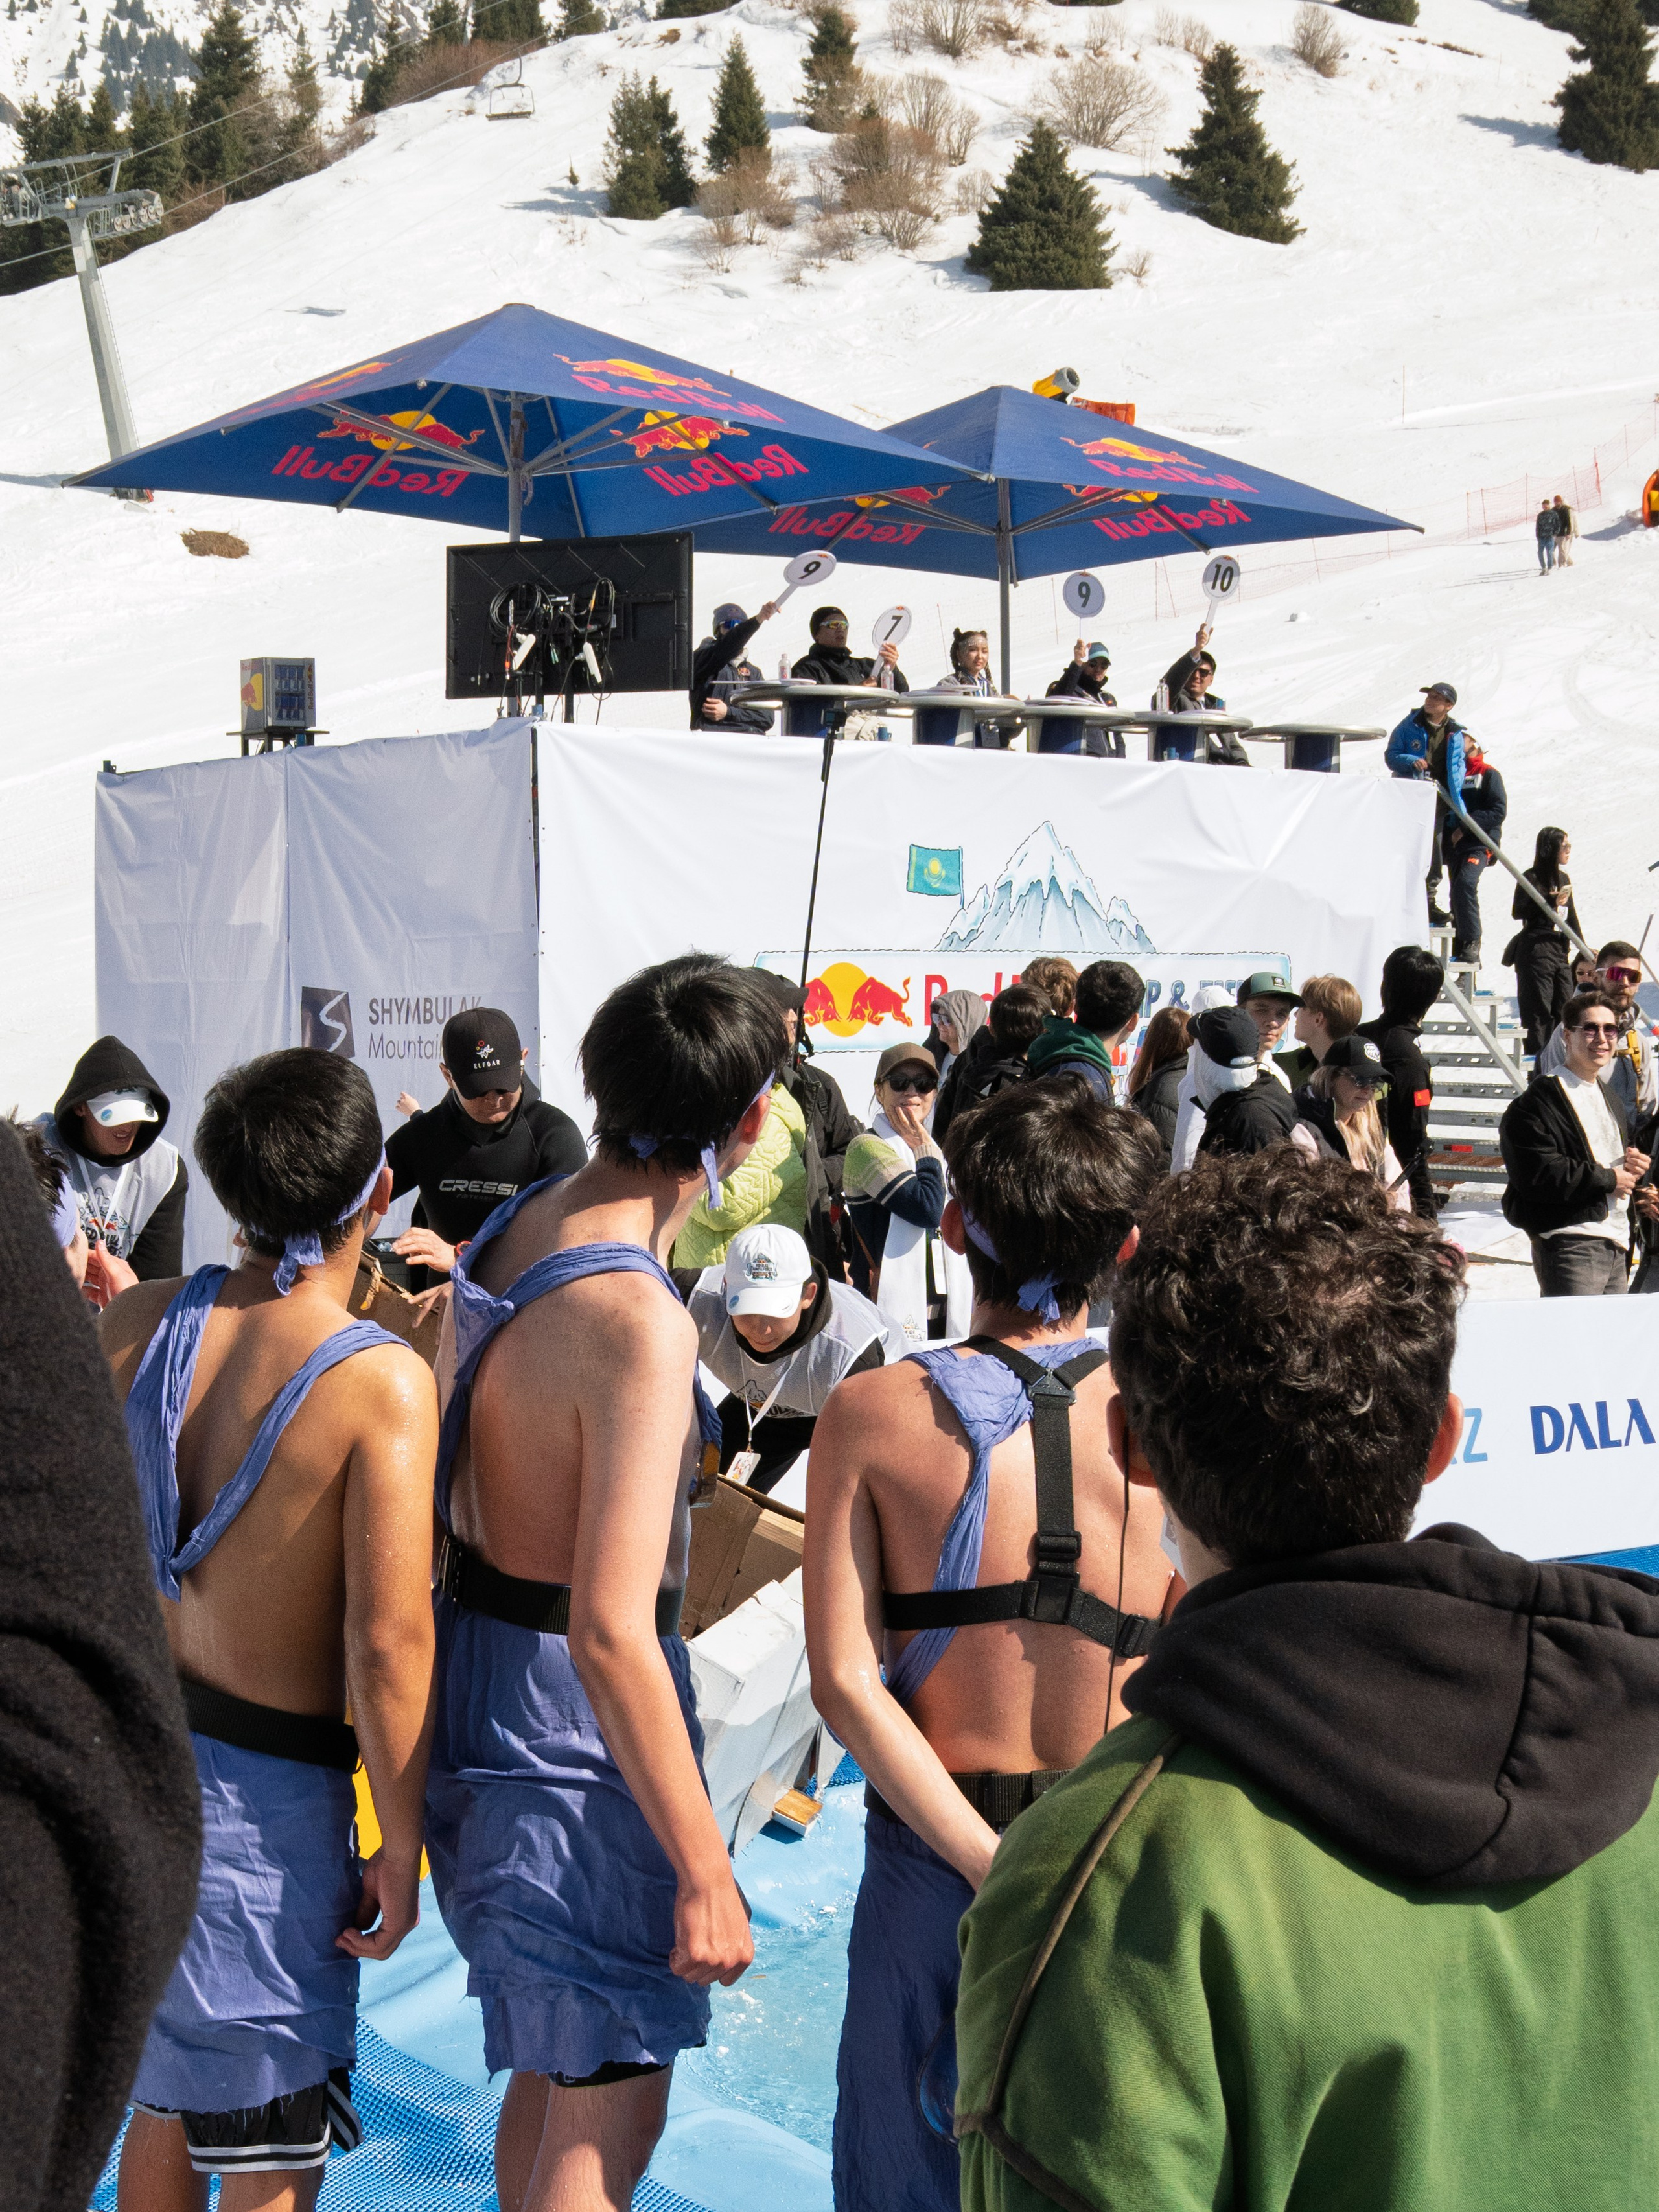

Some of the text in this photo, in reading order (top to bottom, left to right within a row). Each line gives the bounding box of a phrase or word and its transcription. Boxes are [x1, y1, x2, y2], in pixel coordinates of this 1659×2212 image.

[798, 561, 821, 579] 9
[1211, 564, 1234, 592] 10
[1078, 581, 1091, 607] 9
[883, 615, 903, 641] 7
[368, 1033, 443, 1060] Mountai
[439, 1180, 518, 1196] CRESSI
[1530, 1398, 1656, 1455] DALA
